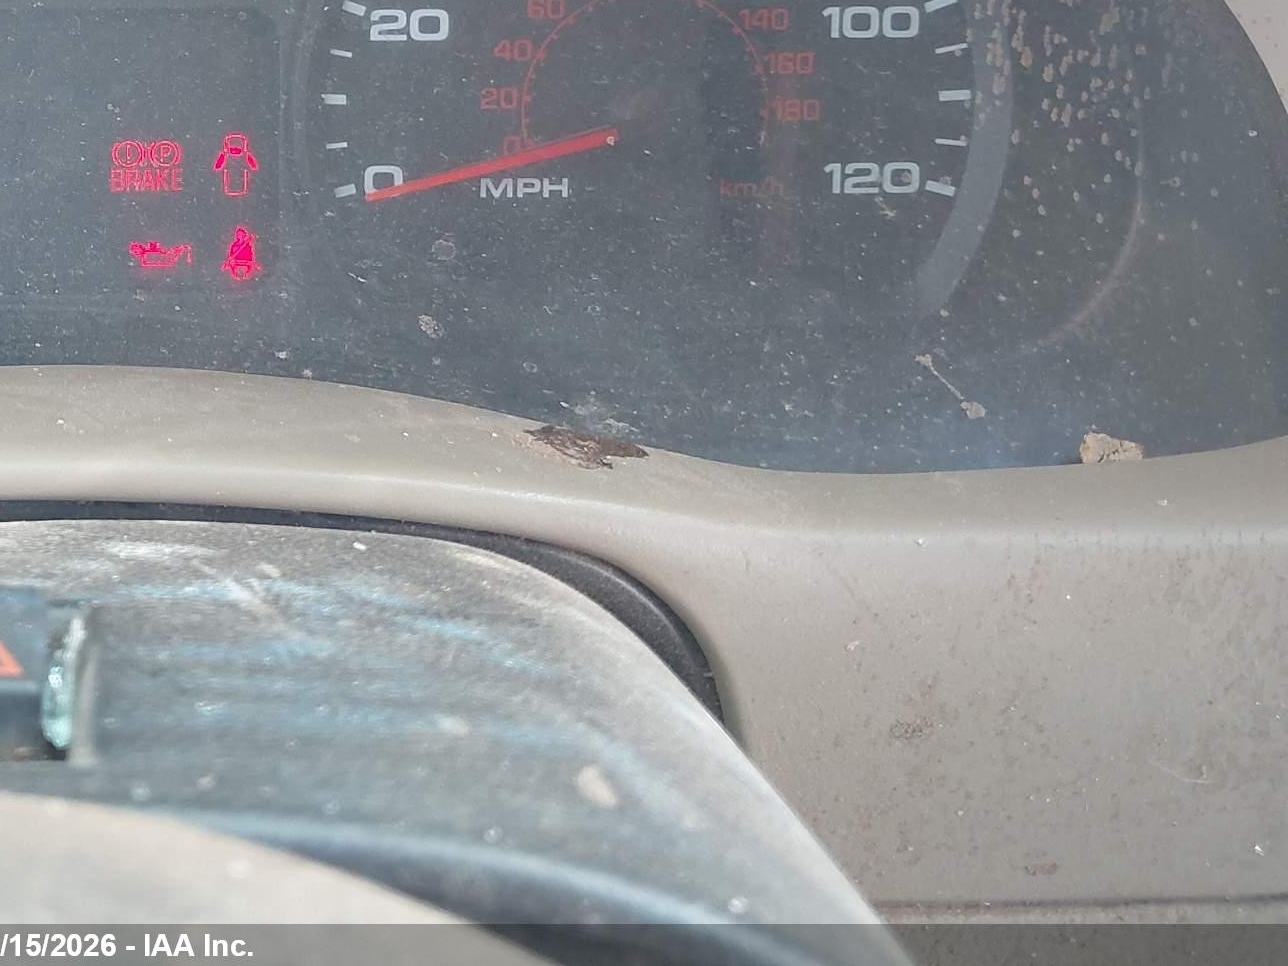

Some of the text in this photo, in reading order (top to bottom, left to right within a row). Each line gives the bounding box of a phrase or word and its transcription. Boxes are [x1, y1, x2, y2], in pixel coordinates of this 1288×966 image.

[369, 8, 449, 42] 20
[739, 8, 790, 31] 140
[822, 6, 920, 40] 100
[493, 40, 533, 61] 40
[765, 52, 815, 74] 160
[480, 88, 518, 110] 20
[769, 99, 822, 121] 180
[110, 168, 183, 192] BRAKE
[364, 165, 403, 197] 0
[479, 177, 568, 198] MPH
[823, 161, 920, 194] 120
